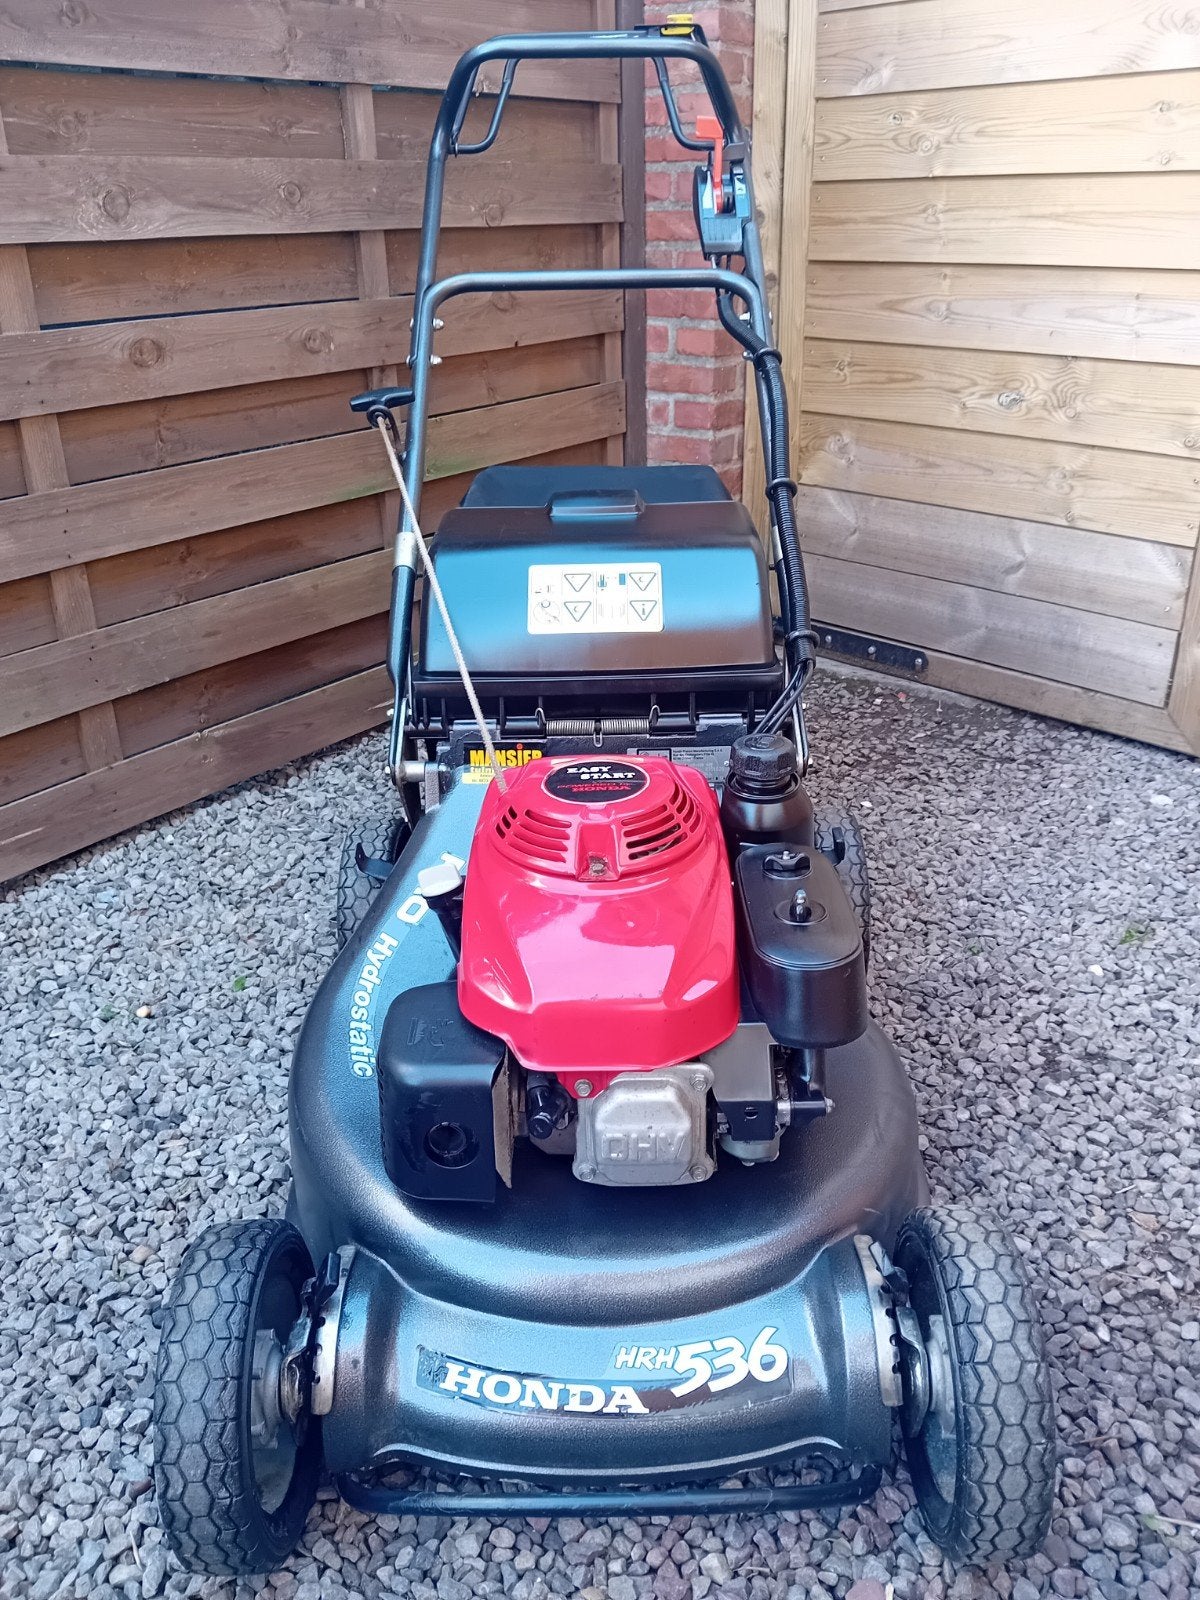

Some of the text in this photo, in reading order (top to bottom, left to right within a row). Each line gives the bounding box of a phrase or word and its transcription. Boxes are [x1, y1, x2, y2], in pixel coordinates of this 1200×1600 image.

[567, 766, 611, 774] EASY
[580, 772, 636, 780] START
[572, 785, 632, 793] HONDA
[348, 932, 399, 1079] Hydrostatic
[601, 1132, 686, 1161] OHV
[440, 1361, 650, 1415] HONDA
